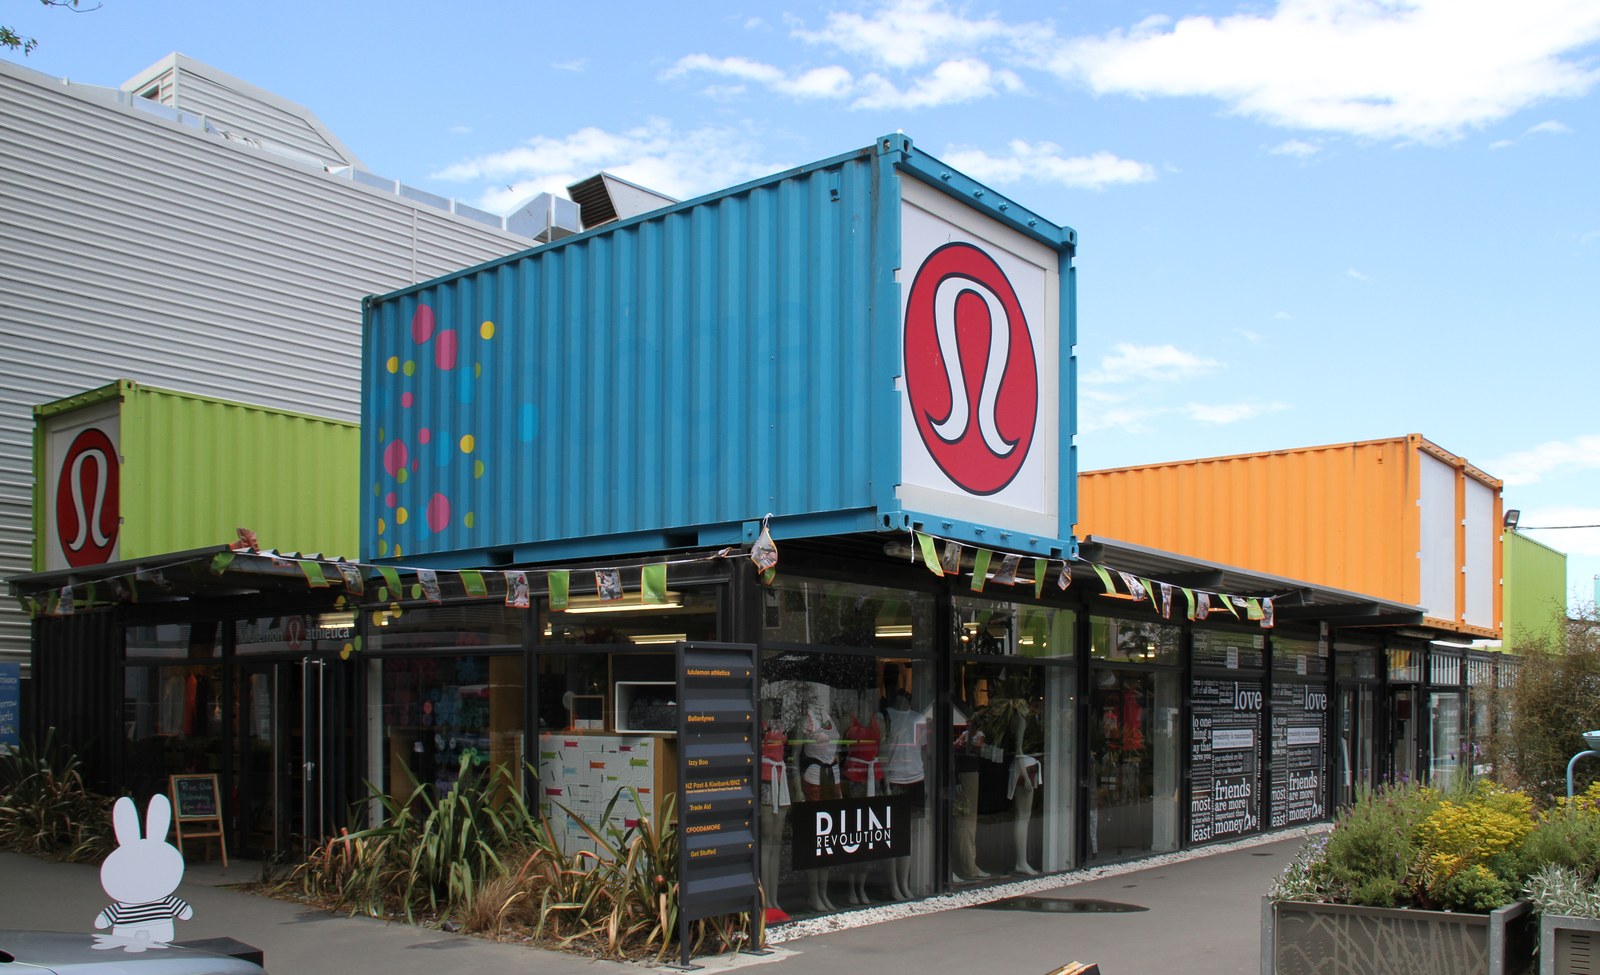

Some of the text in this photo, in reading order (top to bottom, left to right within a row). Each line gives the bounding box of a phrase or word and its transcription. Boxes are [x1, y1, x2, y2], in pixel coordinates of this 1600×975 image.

[1234, 682, 1262, 710] love
[1304, 684, 1327, 710] love
[1289, 770, 1318, 790] friends
[1215, 778, 1250, 800] friends
[1272, 788, 1286, 800] most
[1289, 789, 1313, 799] are more
[1192, 798, 1211, 812] most
[1215, 799, 1246, 811] are more
[1272, 813, 1286, 827] east
[1289, 806, 1312, 821] money
[686, 824, 721, 833] CFOOD&MORE
[1215, 819, 1243, 833] money
[816, 829, 891, 848] REVOLUTION
[1192, 825, 1211, 842] least
